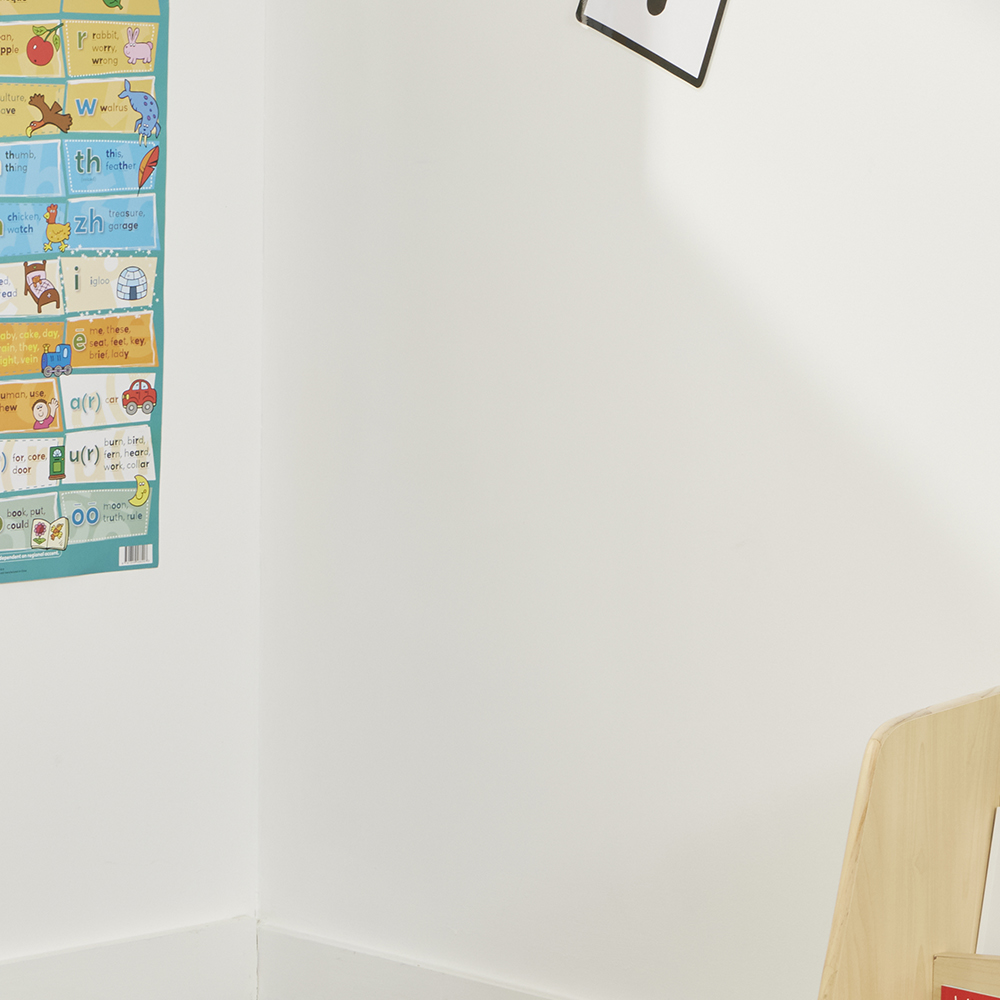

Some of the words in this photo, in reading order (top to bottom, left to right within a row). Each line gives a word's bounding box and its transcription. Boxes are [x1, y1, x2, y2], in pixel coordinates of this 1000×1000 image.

[78, 31, 87, 48] r
[93, 32, 119, 40] rabbit,
[92, 45, 117, 53] worry,
[92, 57, 118, 66] wrong
[76, 99, 97, 115] w
[100, 104, 128, 112] walrus
[5, 151, 36, 160] thumb,
[106, 150, 123, 158] this,
[75, 148, 100, 173] th
[5, 164, 28, 173] thing
[106, 162, 136, 170] feather
[8, 213, 41, 221] chicken,
[109, 210, 145, 218] treasure,
[75, 209, 103, 233] zh
[8, 224, 33, 233] watch
[109, 222, 138, 231] garage
[75, 266, 78, 290] i
[90, 277, 110, 287] igloo
[19, 330, 41, 339] cake,
[42, 329, 60, 339] day,
[90, 327, 104, 335] me,
[107, 325, 131, 333] these,
[90, 338, 108, 347] seat,
[110, 338, 128, 346] feet,
[130, 337, 147, 346] key,
[19, 343, 39, 352] they,
[90, 350, 109, 359] brief,
[111, 350, 129, 359] lady
[30, 390, 46, 398] use,
[71, 393, 101, 413] a(r)
[106, 396, 118, 404] car
[104, 438, 125, 446] burn,
[127, 436, 145, 444] bird,
[13, 453, 26, 462] for,
[28, 453, 47, 461] core,
[70, 445, 99, 466] u(r)
[104, 450, 122, 459] fern,
[104, 462, 125, 470] work,
[126, 460, 150, 469] collar
[13, 466, 31, 474] door
[103, 502, 129, 510] moon,
[7, 508, 28, 517] book,
[30, 507, 46, 516] put,
[103, 513, 125, 522] truth,
[127, 512, 142, 520] rule
[7, 521, 29, 530] could
